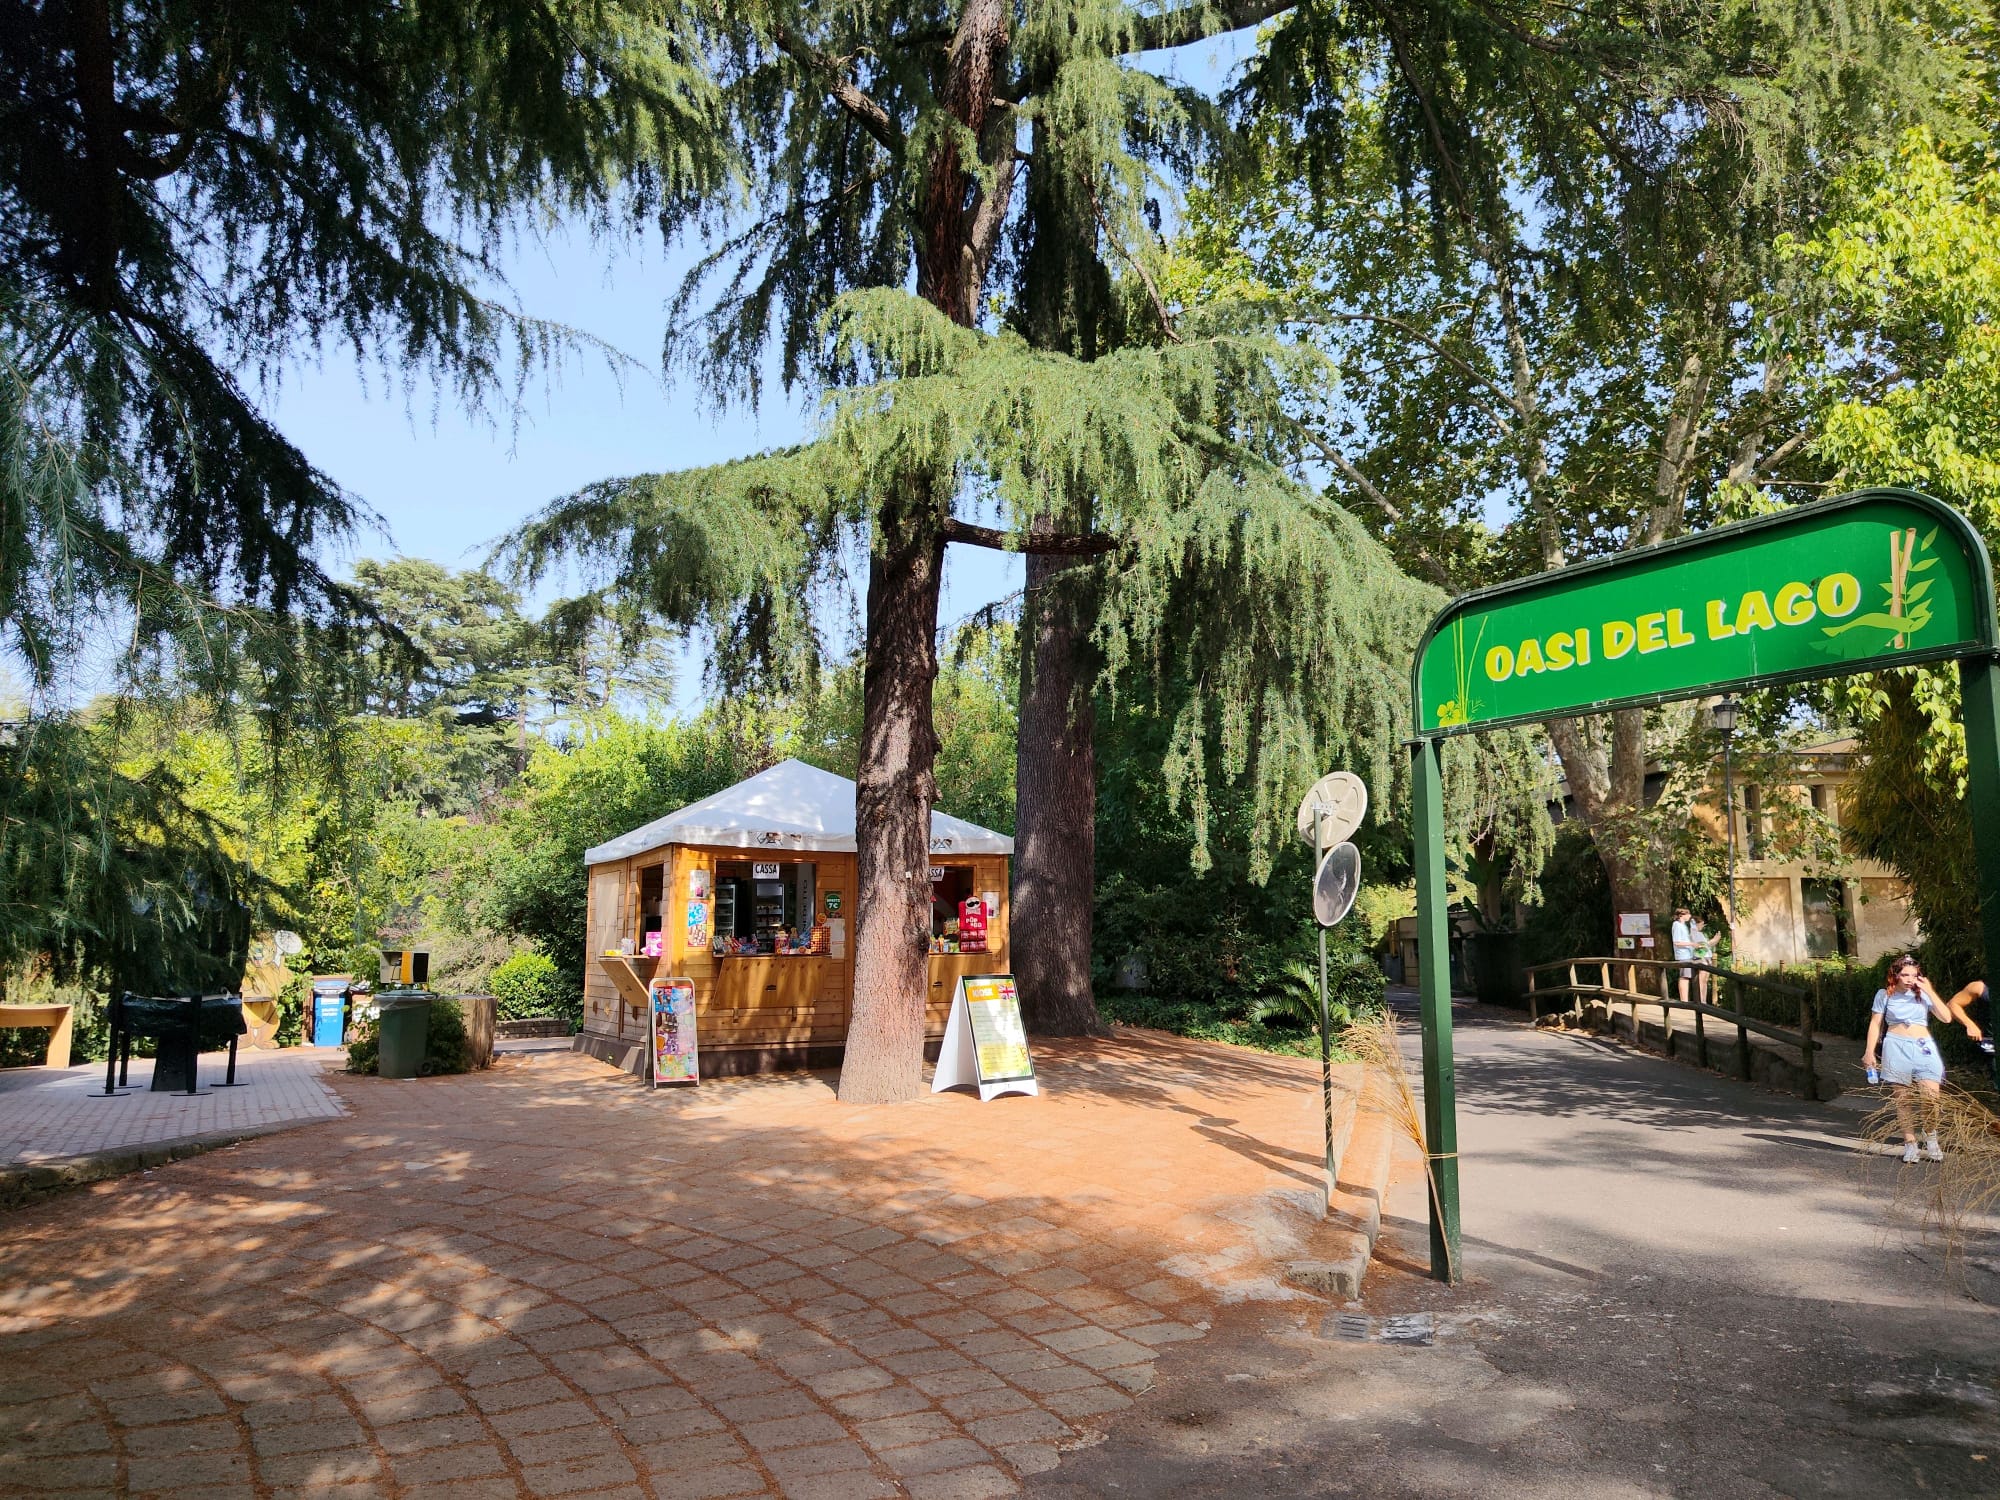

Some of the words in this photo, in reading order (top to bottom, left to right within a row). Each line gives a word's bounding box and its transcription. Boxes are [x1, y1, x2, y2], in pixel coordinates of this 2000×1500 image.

[1485, 627, 1591, 682] OASI
[1602, 608, 1696, 660] DEL
[1706, 572, 1862, 641] LAGO
[755, 864, 777, 874] CASSA
